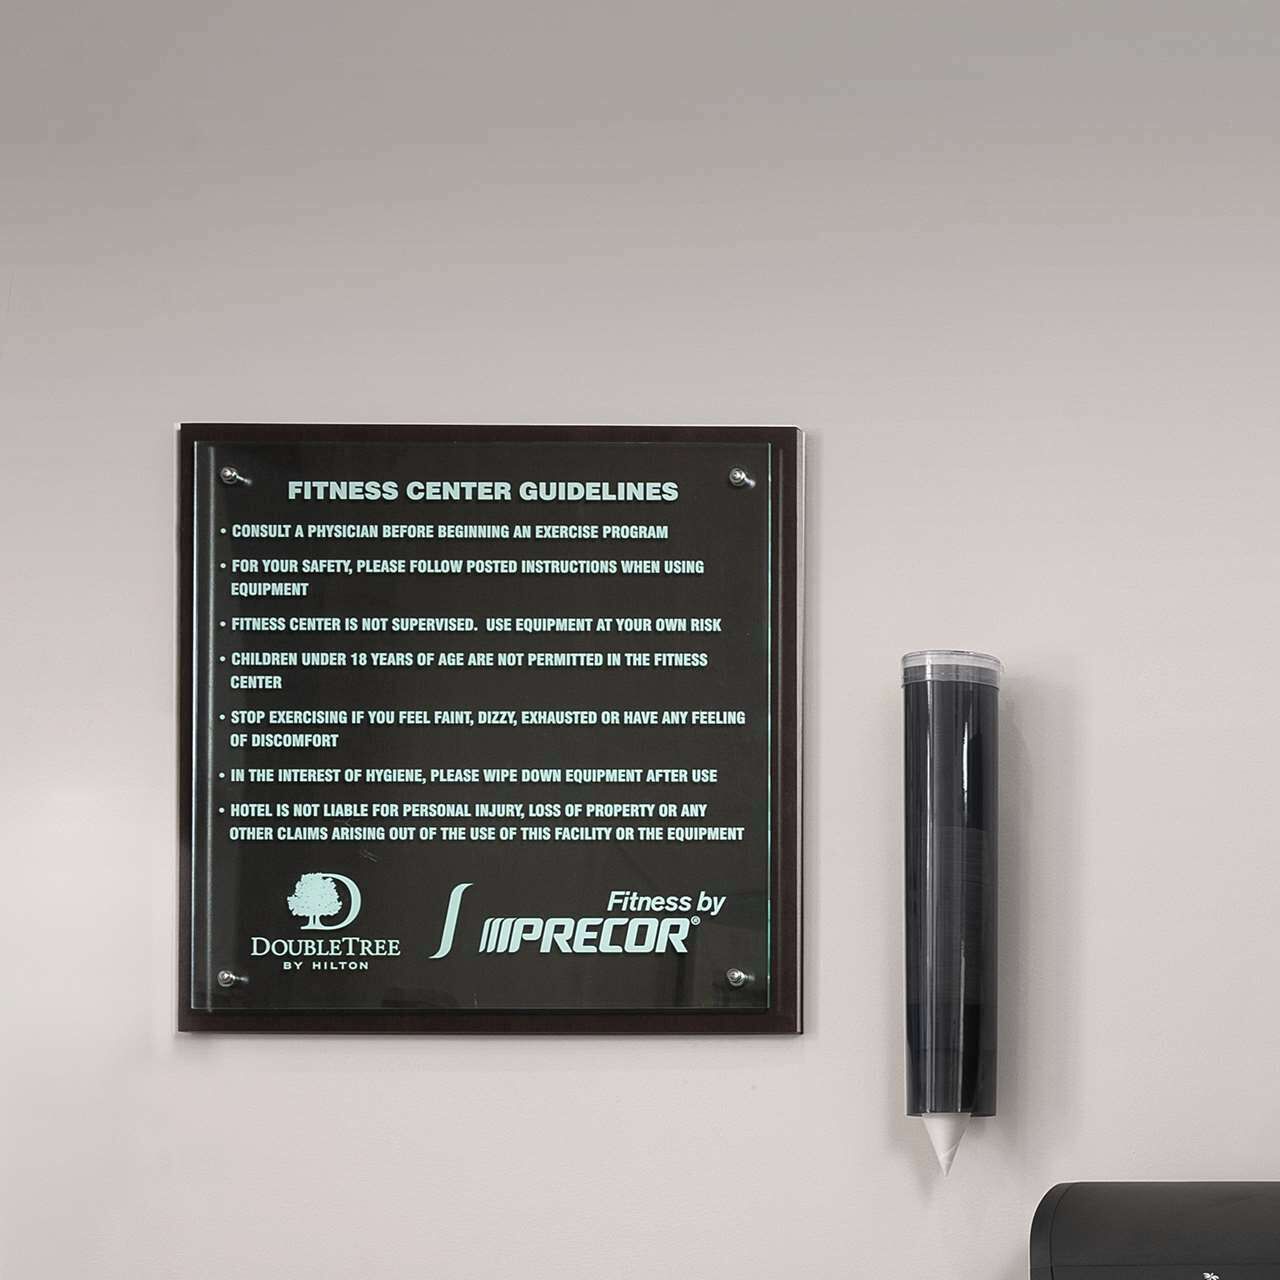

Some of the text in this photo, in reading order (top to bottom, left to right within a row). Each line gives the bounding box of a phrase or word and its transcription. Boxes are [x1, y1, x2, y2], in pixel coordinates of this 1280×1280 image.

[289, 481, 678, 501] FITNESS CENTER GUIDELINES
[233, 525, 668, 538] CONSULT A PHYSICIAN BEFORE BEGINNING AN EXERCISE PROGRAM
[232, 559, 704, 574] FOR YOUR SAFETY, PLEASE FOLLOW POSTED INSTRUCTIONS WHEN USING
[231, 583, 309, 597] EQUIPMENT
[232, 617, 721, 632] FITNESS CENTER IS NOT SUPERVISED. USE EQUIPMENT AT YOUR OWN RISK
[232, 652, 707, 666] CHILDREN UNDER 18 YEARS OF AGE ARE NOT PERMITTED IN THE FITNESS
[231, 676, 281, 688] CENTER
[231, 711, 745, 726] STOP EXERCISING IF YOU FEEL FAINT, DIZZY, EXHAUSTED OR HAVE ANY FEELING
[231, 734, 339, 747] OF DISCOMFORT
[231, 769, 717, 784] IN THE INTEREST OF HYGIENE, PLEASE WIPE DOWN EQUIPMENT AFTER USE
[231, 804, 707, 819] HOTEL IS NOT LIABLE FOR PERSONAL INJURY, LOSS OF PROPERTY OR ANY
[230, 827, 744, 841] OTHER CLAIMS ARISING OUT OF THE USE OF THIS FACILITY OR THE EQUIPMENT
[607, 891, 726, 916] Fitness by
[283, 961, 369, 970] BY HILTON
